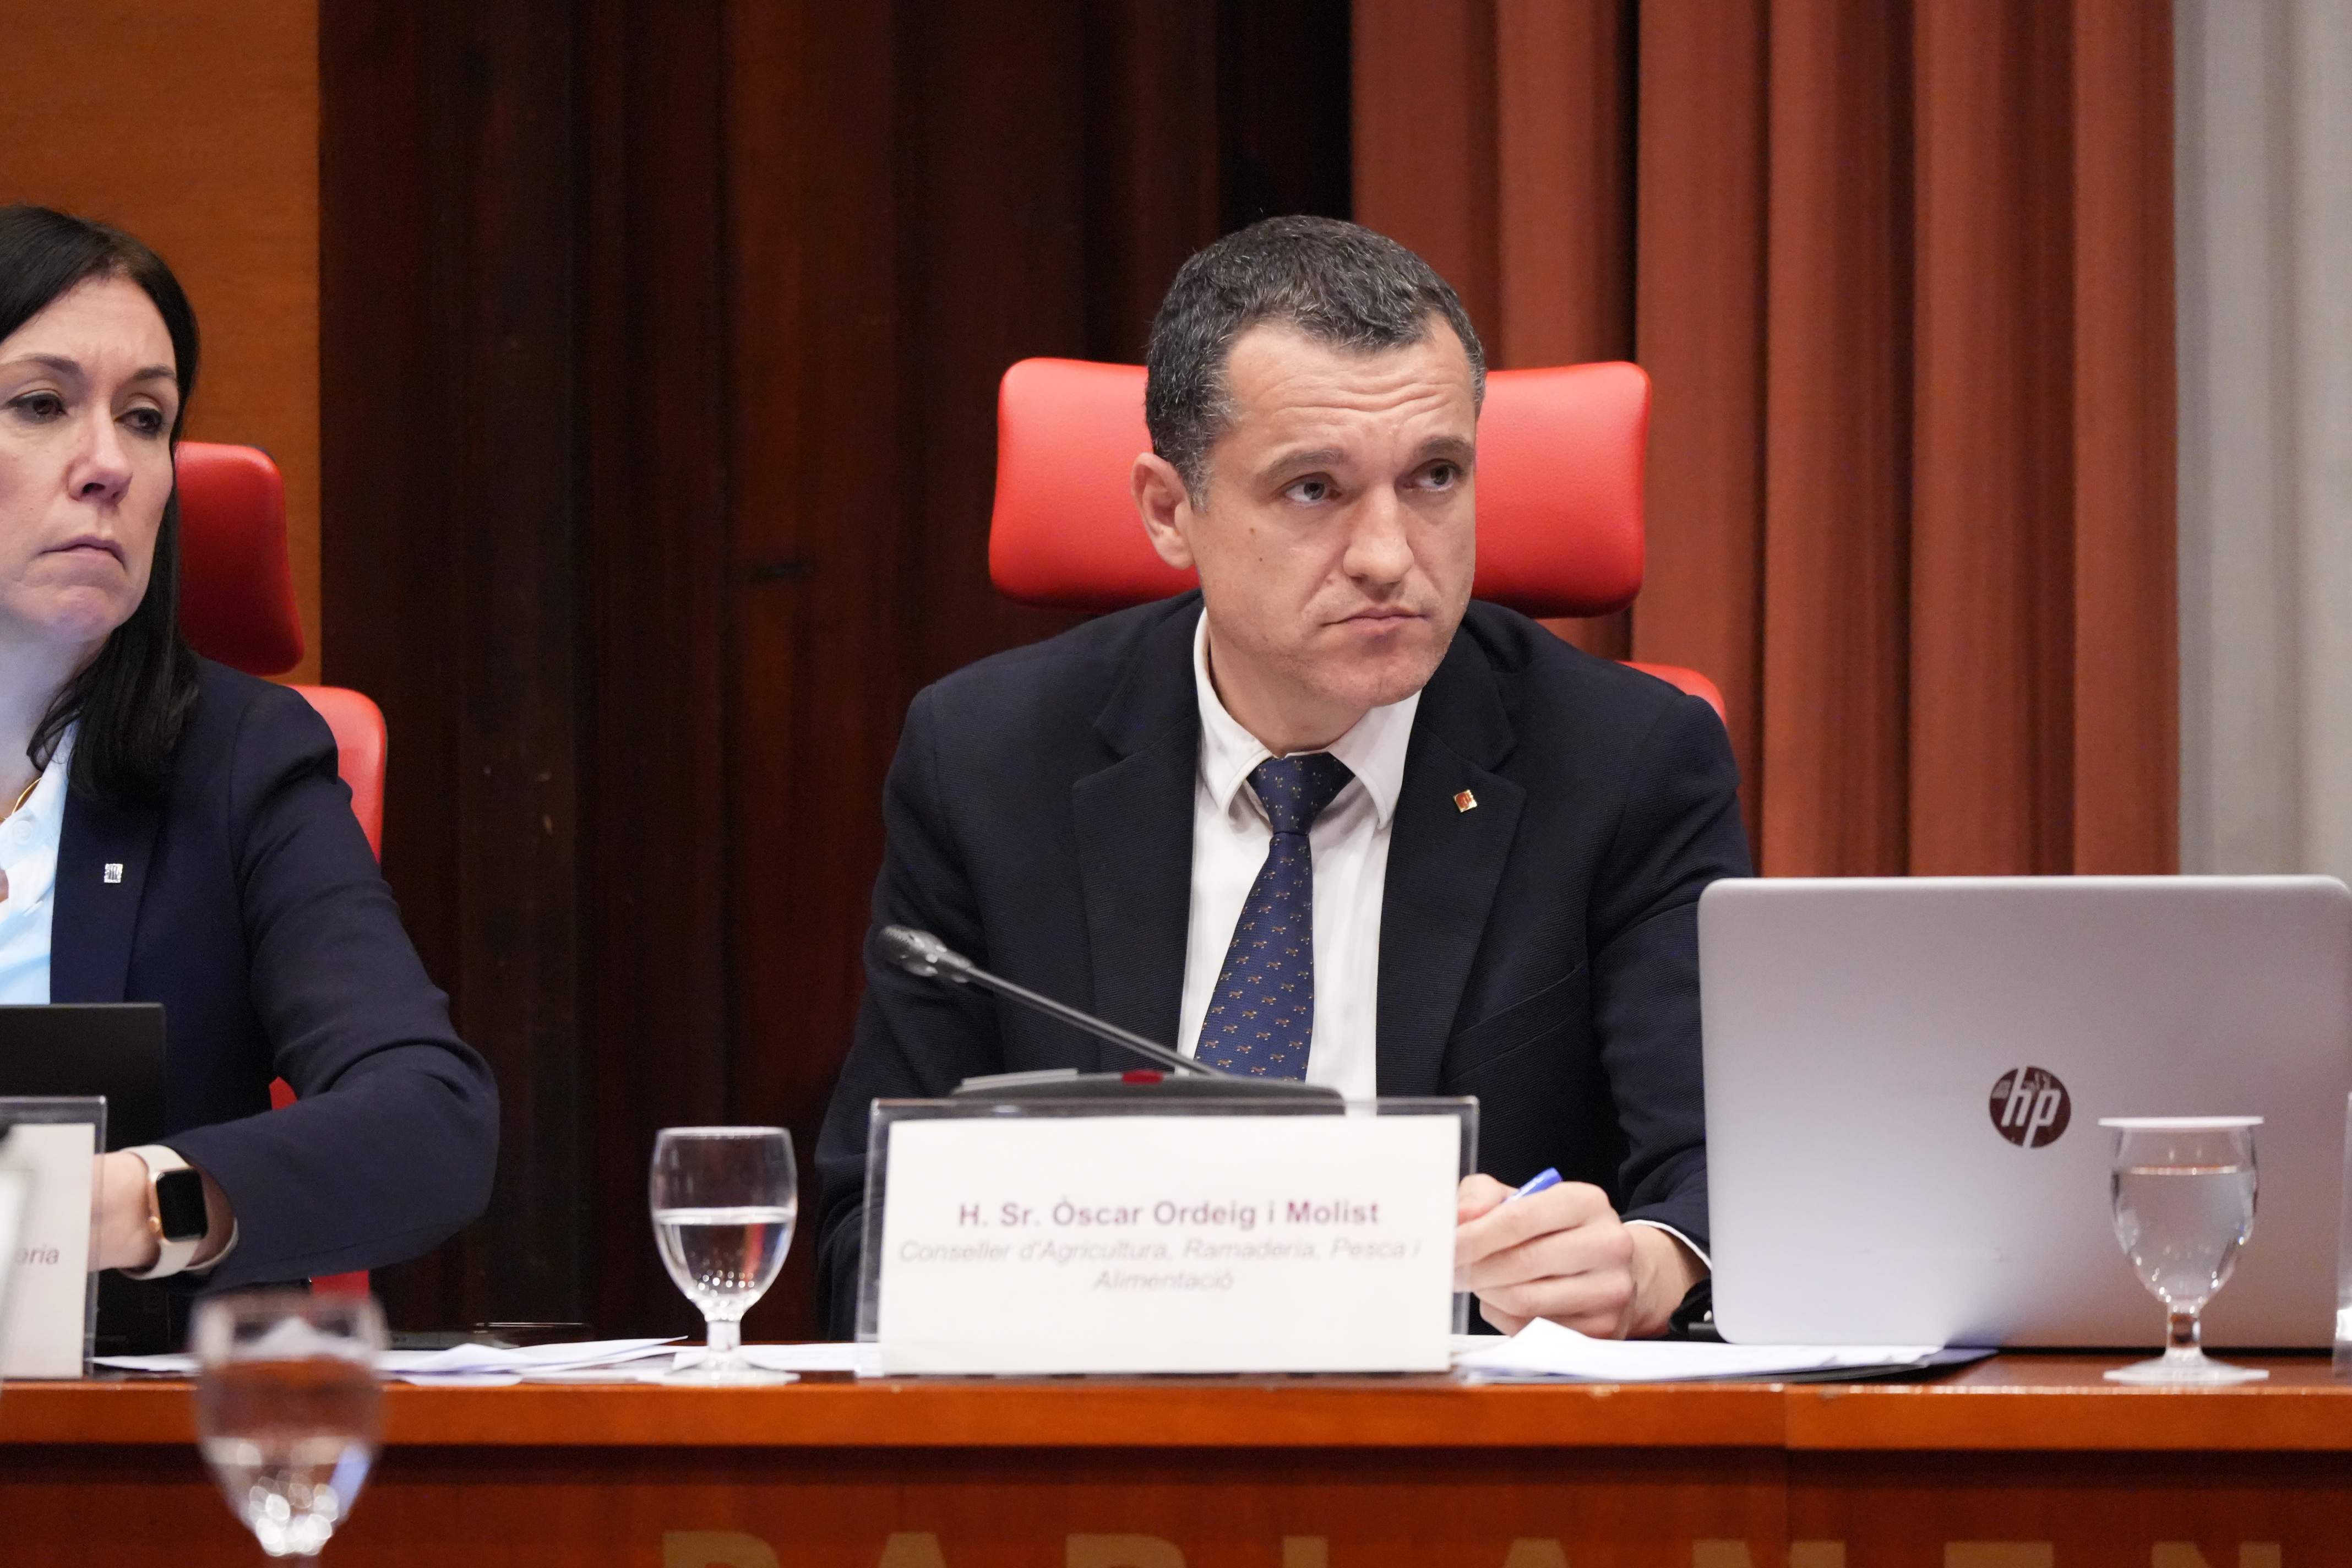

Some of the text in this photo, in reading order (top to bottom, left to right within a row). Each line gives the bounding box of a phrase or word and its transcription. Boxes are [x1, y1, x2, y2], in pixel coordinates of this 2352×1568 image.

[959, 1194, 1380, 1229] H. Sr. Òscar Ordeig i Molist
[900, 1239, 1010, 1261] Conseller
[1331, 1237, 1406, 1259] Pesca
[1413, 1238, 1422, 1257] i
[1093, 1270, 1233, 1291] Alimentació
